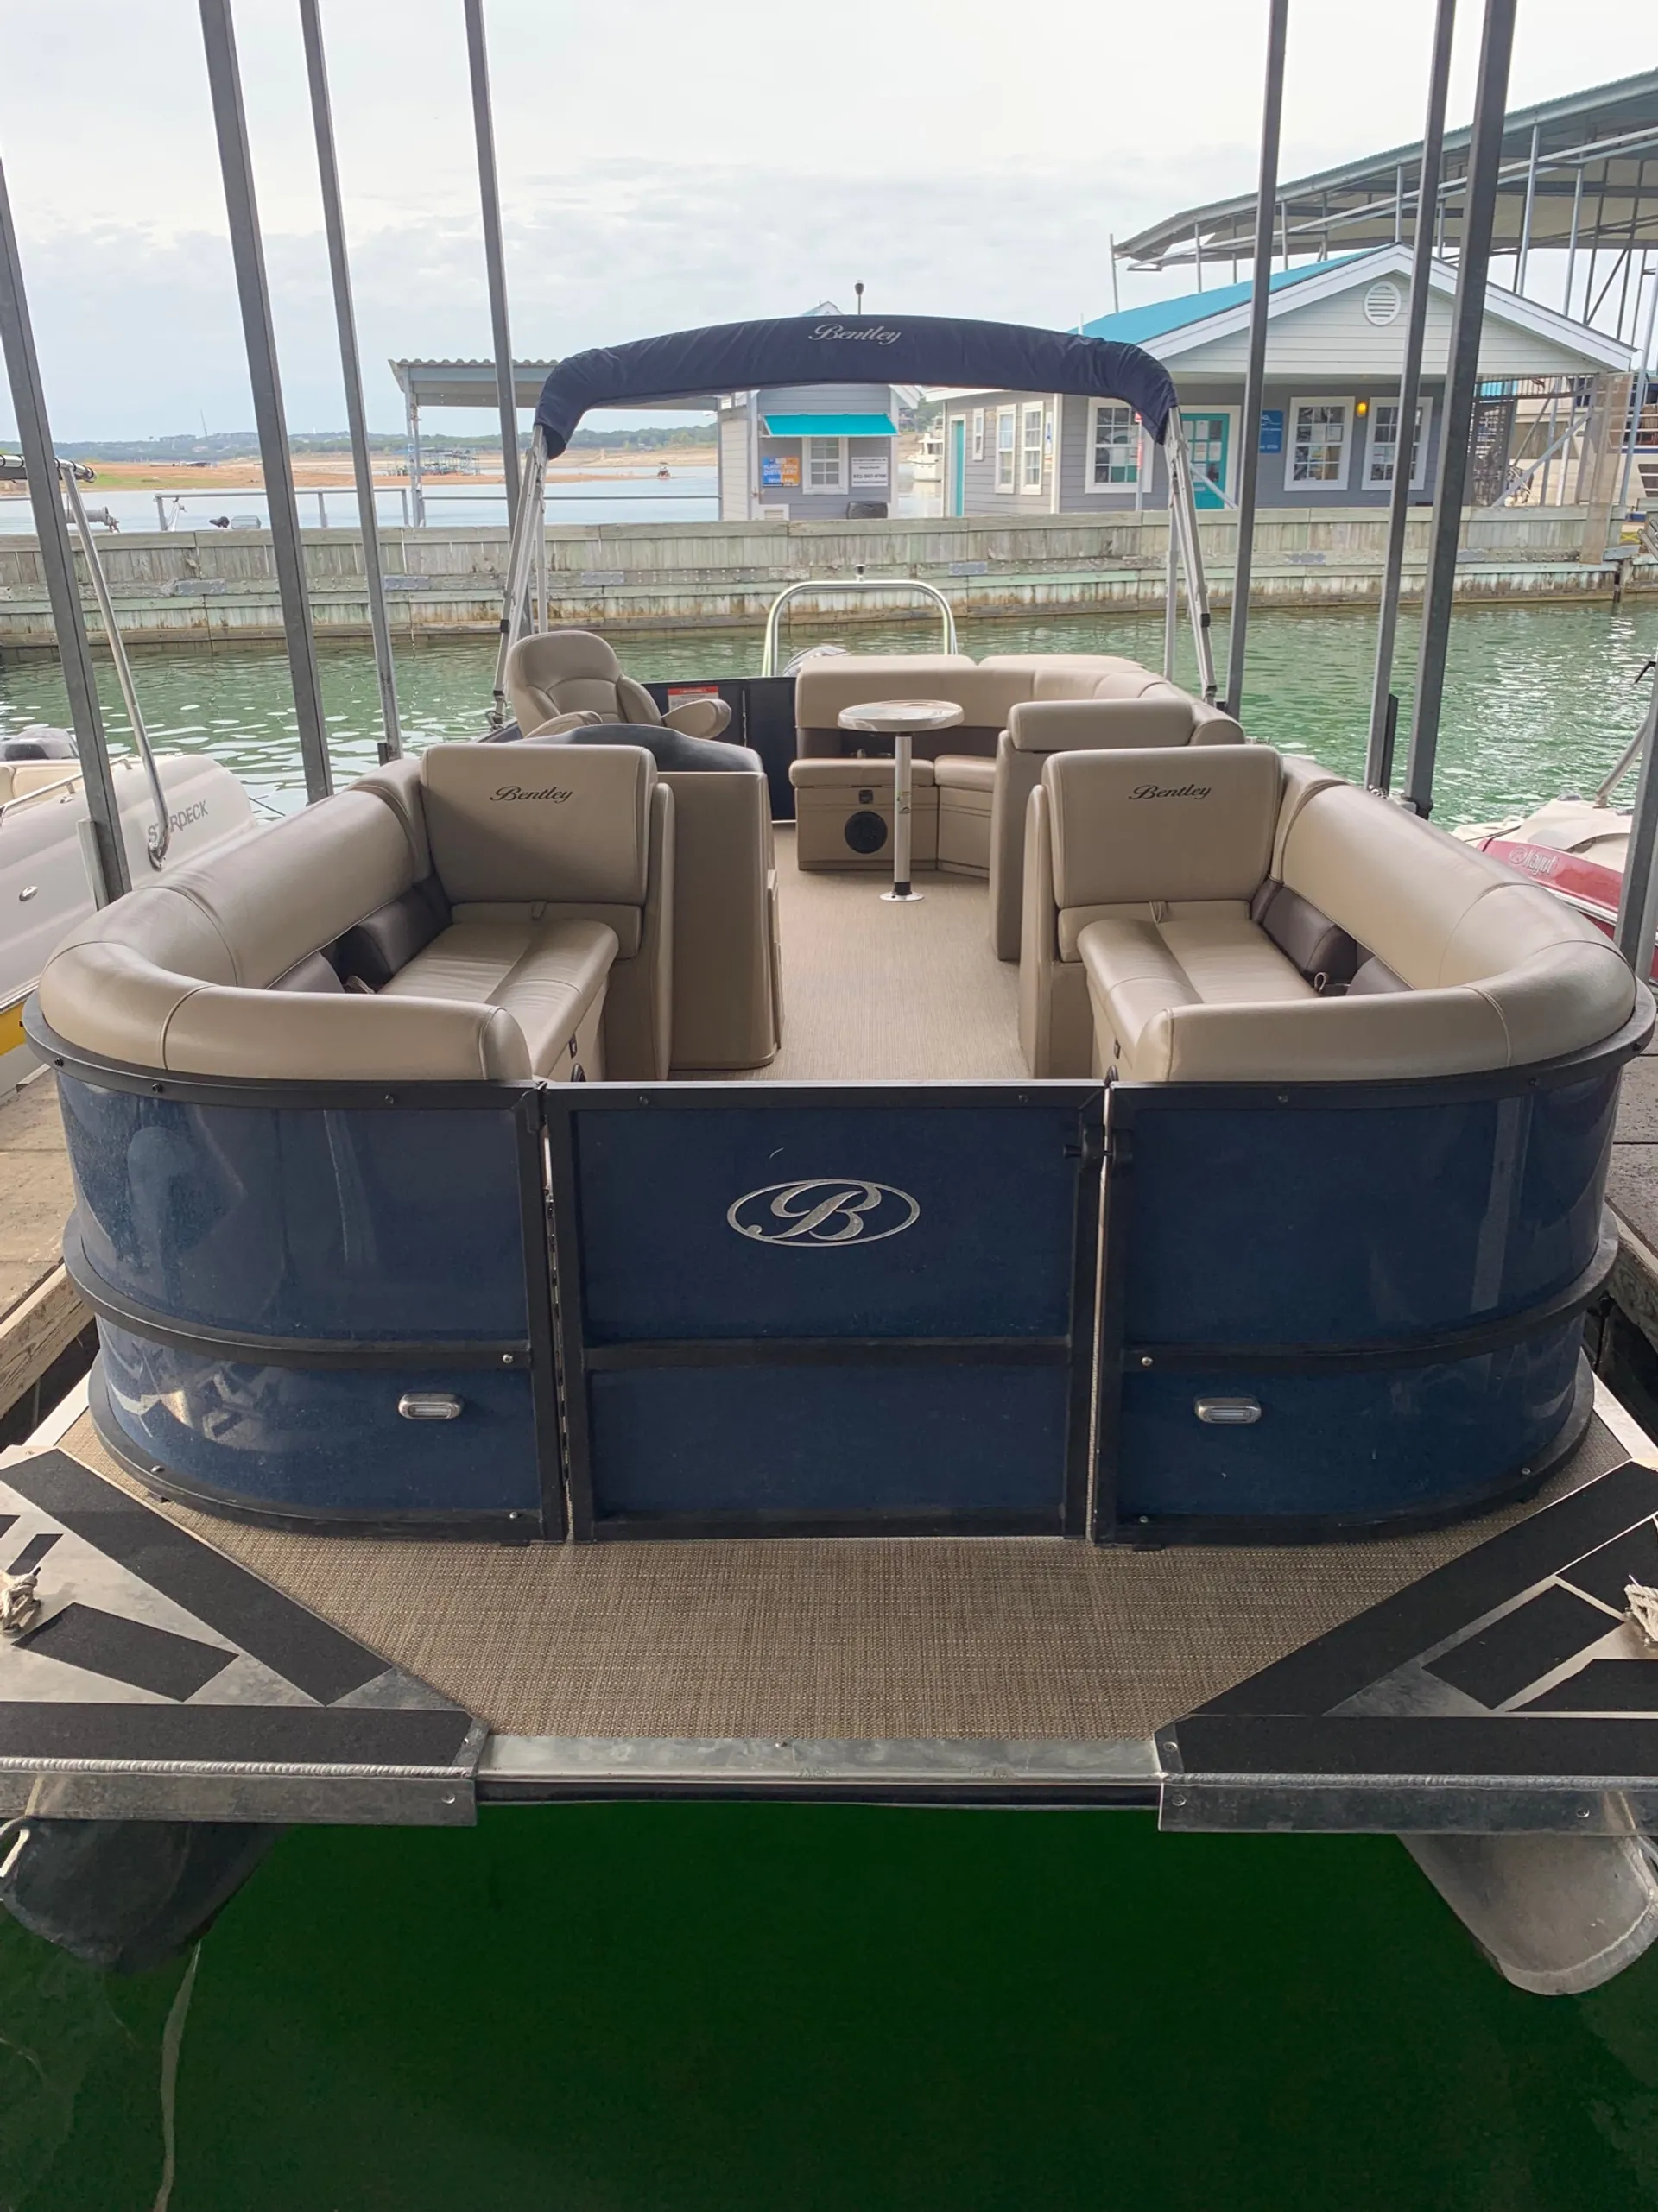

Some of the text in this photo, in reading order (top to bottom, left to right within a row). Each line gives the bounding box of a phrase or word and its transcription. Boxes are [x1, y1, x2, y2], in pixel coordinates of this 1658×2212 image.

[807, 323, 902, 346] Bentley
[490, 785, 573, 804] Bentley
[1128, 783, 1212, 800] Bentley
[147, 799, 209, 843] SRDECK
